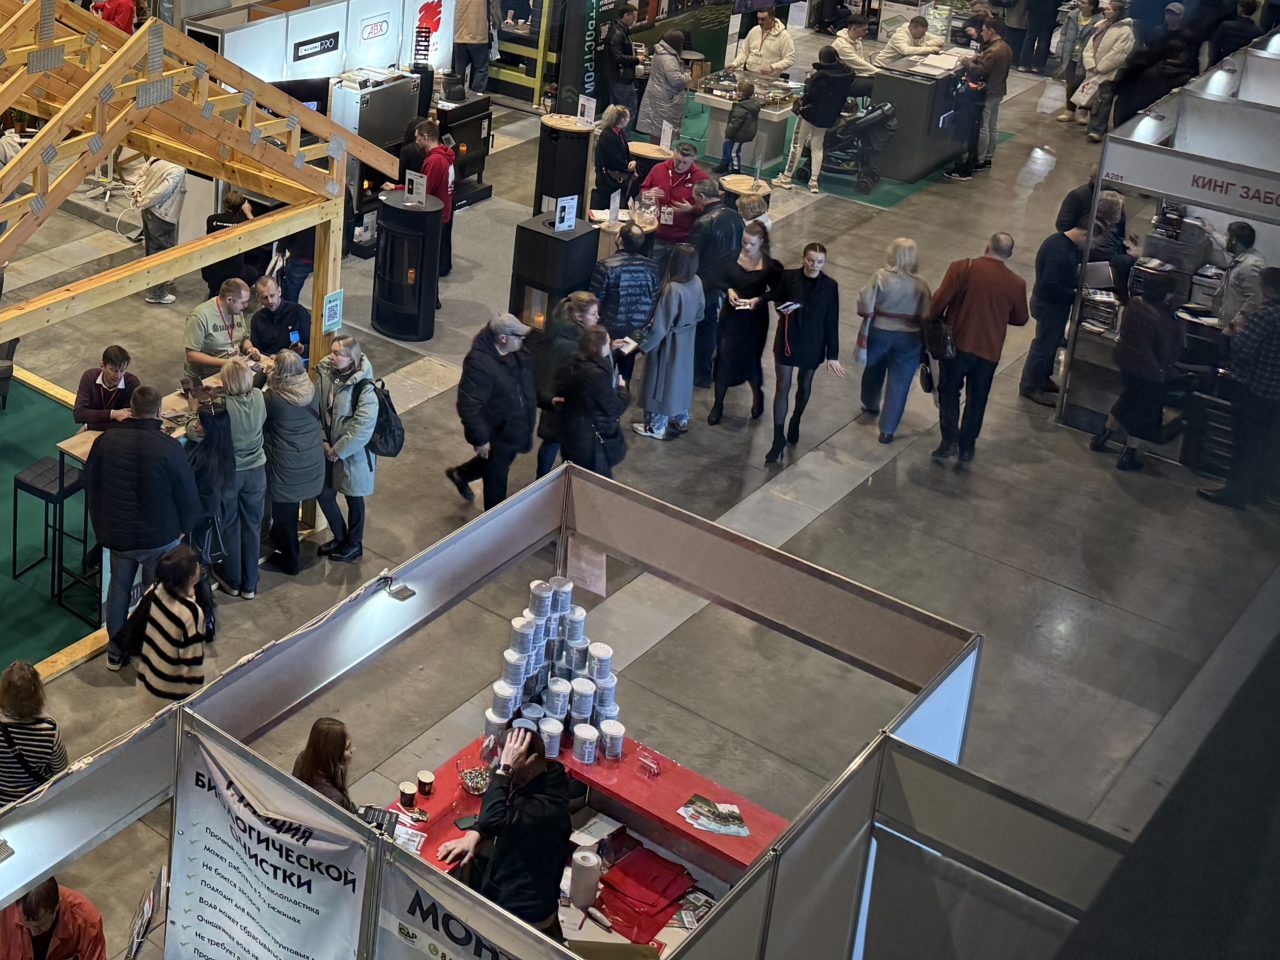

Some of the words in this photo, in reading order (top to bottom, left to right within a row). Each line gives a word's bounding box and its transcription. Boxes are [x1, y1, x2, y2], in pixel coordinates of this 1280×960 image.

[1104, 171, 1124, 182] A201
[1191, 173, 1236, 196] КИНГ
[203, 844, 227, 864] Может
[229, 825, 313, 895] ОЧИСТКИ
[202, 860, 213, 872] Не
[214, 868, 238, 890] боится
[205, 826, 235, 851] Прочный
[261, 880, 320, 917] стеклопластика
[200, 879, 234, 904] Подходит
[198, 896, 218, 911] Вода
[218, 908, 239, 927] может
[195, 930, 206, 942] Не
[206, 937, 236, 959] требует
